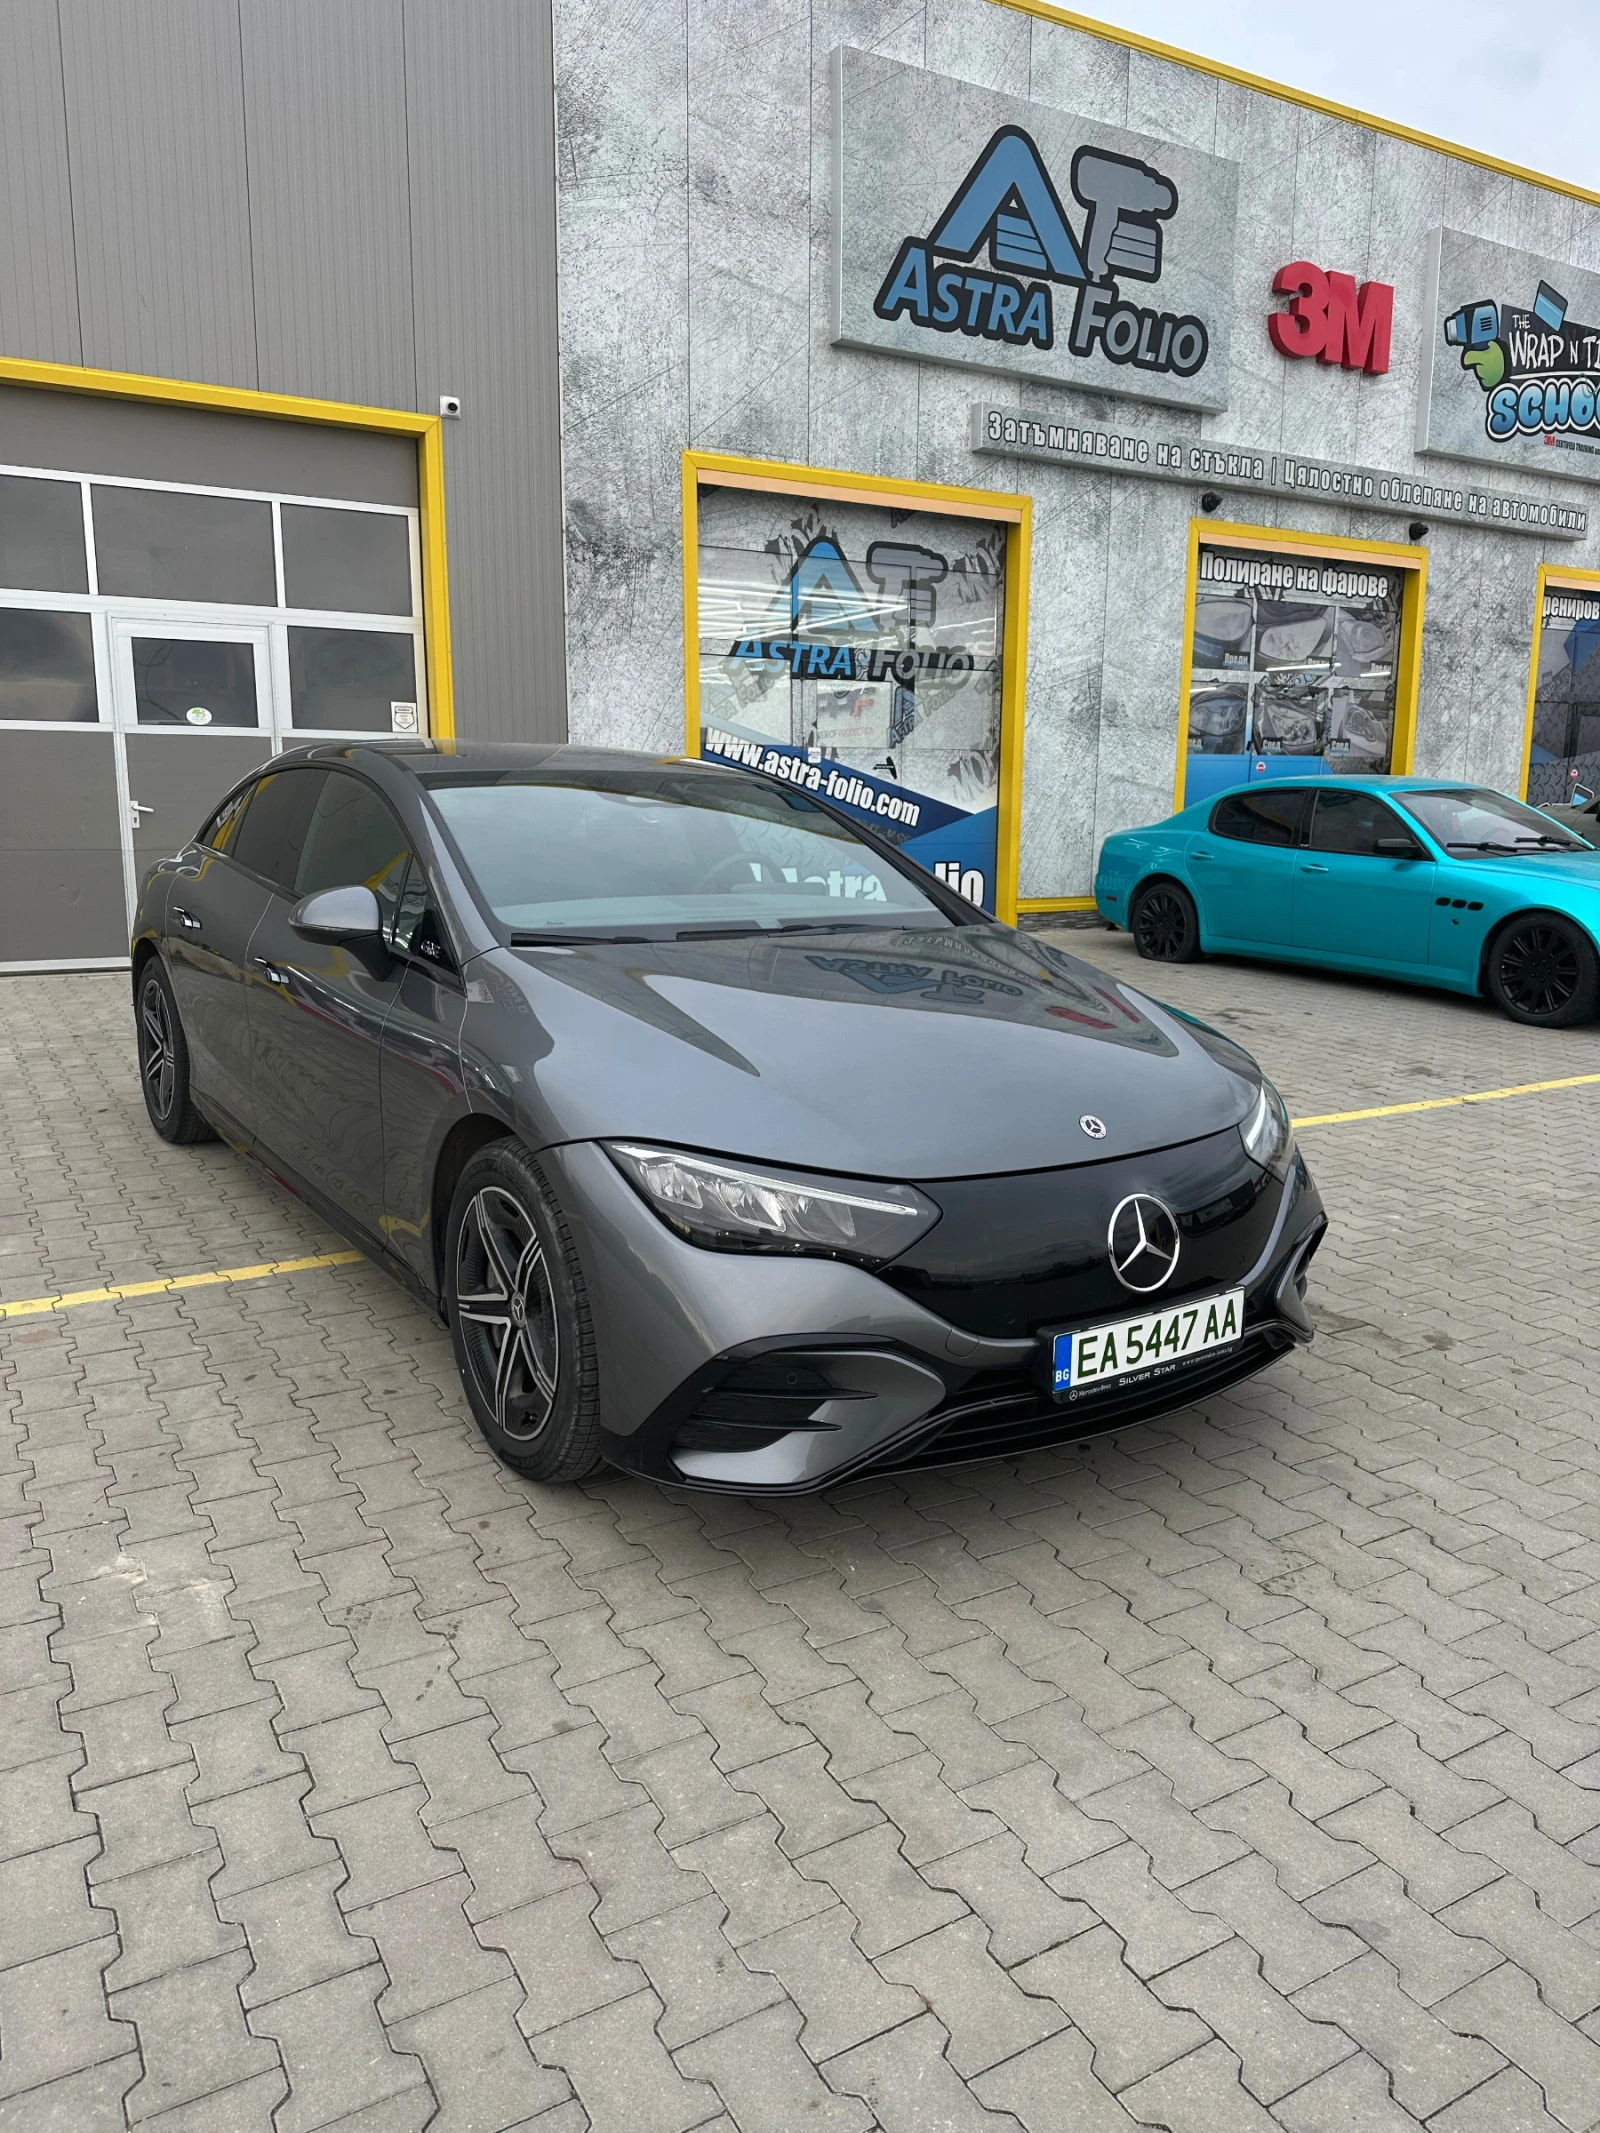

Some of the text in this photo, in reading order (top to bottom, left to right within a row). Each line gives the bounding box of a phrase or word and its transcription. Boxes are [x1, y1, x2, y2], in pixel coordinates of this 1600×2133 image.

[880, 245, 1203, 369] ASTRA FOLIO
[1268, 261, 1394, 376] 3M
[1512, 313, 1531, 330] THE
[1508, 331, 1565, 369] WRAP
[1569, 339, 1579, 365] N
[1489, 378, 1600, 435] SCHO
[987, 410, 1587, 532] Затъмняване на стъкла Цялостно облепяне на автомобили
[1200, 551, 1389, 599] Полиране на фарове
[729, 627, 971, 686] ASTRA FOLIO
[705, 727, 921, 828] www.astra-folio.com
[1077, 1299, 1237, 1379] EA 5447 AA
[1055, 1368, 1071, 1384] BG
[1118, 1372, 1151, 1387] SILVER
[1153, 1364, 1177, 1377] STAR
